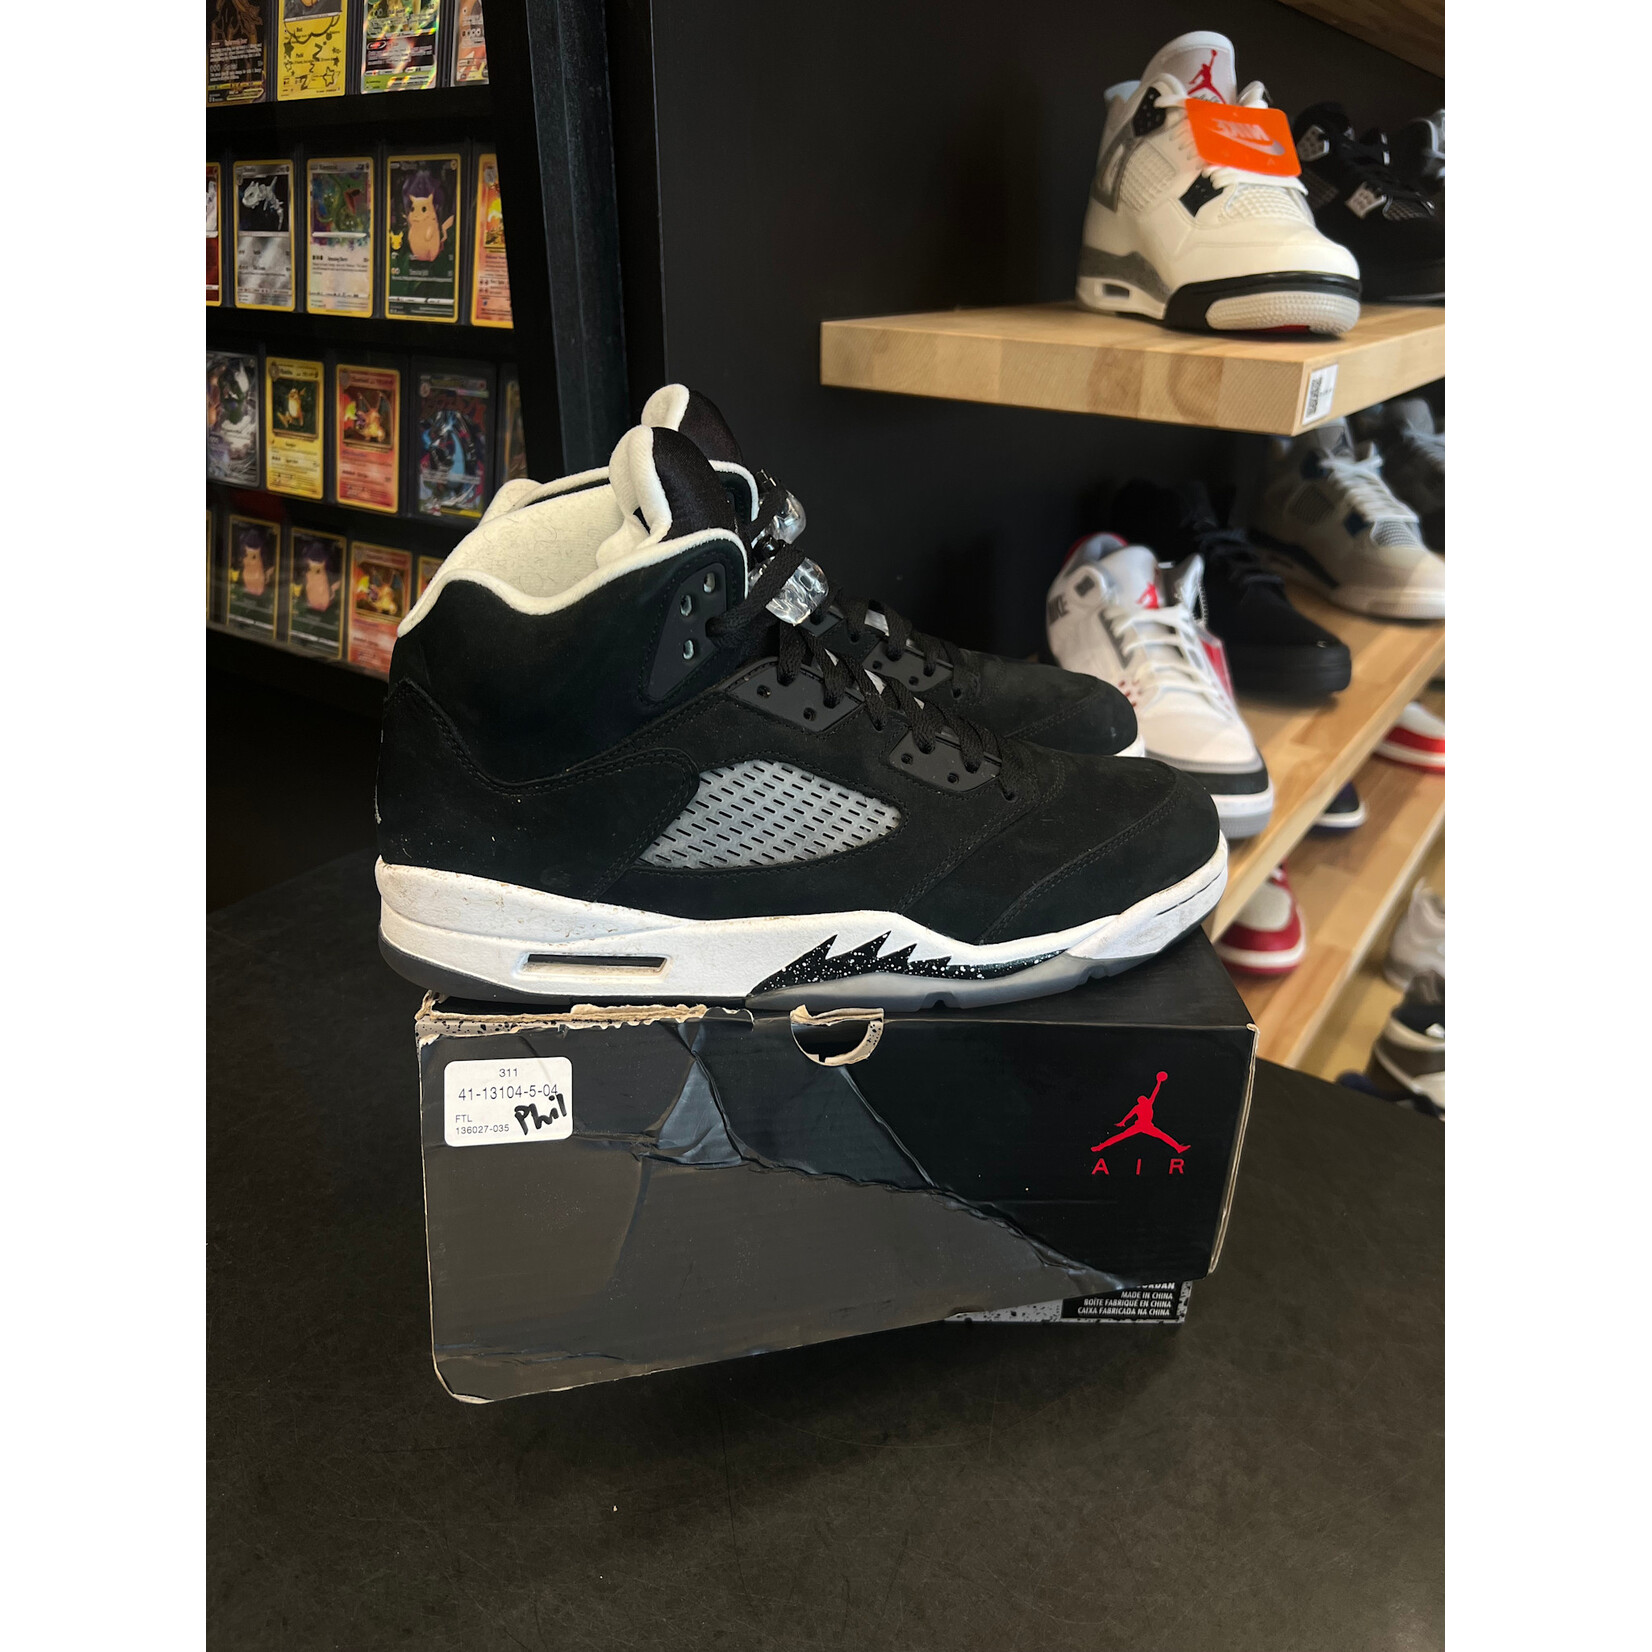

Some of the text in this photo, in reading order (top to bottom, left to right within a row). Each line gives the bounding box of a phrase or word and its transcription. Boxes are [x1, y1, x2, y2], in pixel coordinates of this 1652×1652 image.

[499, 1068, 518, 1078] 311
[458, 1084, 558, 1101] 41-13104-5-04
[455, 1114, 473, 1123] FTL
[514, 1093, 567, 1136] Phil
[456, 1124, 510, 1135] 136027-035
[1121, 1291, 1141, 1299] MADE
[1152, 1292, 1174, 1300] CHINA
[1140, 1299, 1149, 1307] EN
[1150, 1299, 1172, 1308] CHINA
[1078, 1306, 1098, 1314] CAIXA
[1099, 1307, 1136, 1315] FABRICADA
[1149, 1308, 1170, 1316] CHINA
